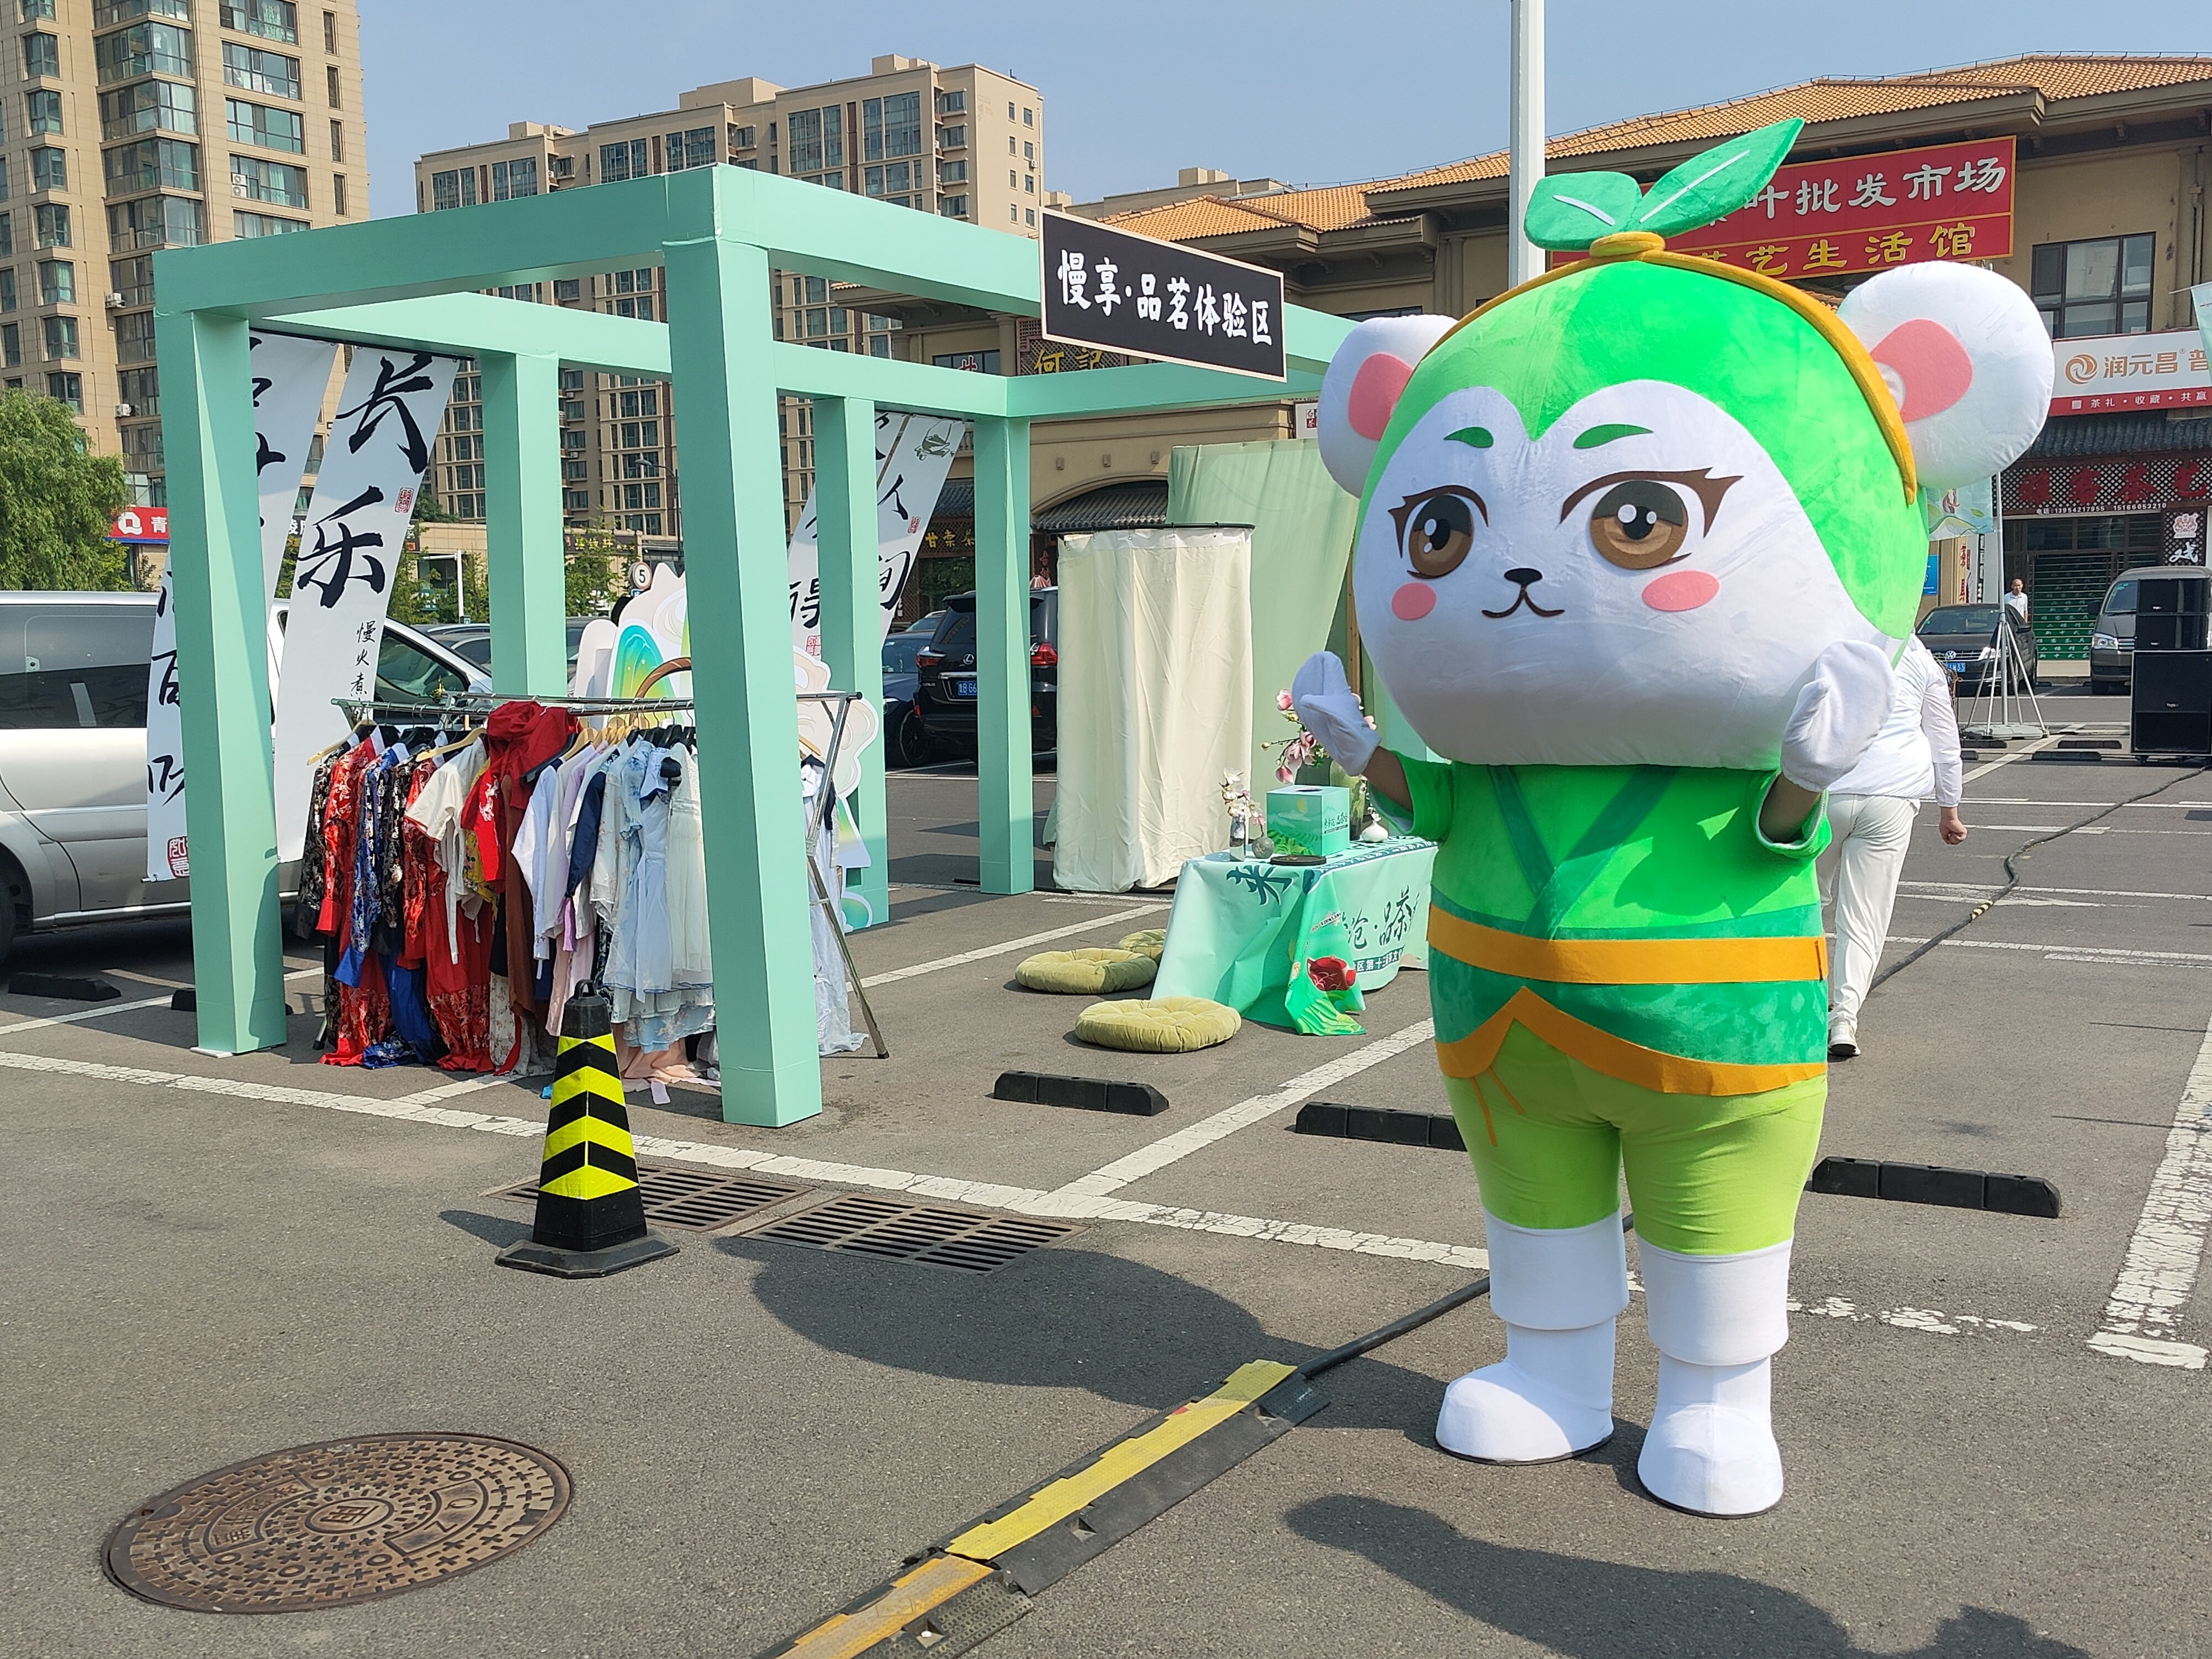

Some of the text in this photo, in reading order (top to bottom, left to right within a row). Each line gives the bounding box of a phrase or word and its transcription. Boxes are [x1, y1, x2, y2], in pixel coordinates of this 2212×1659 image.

[1709, 156, 2006, 226] 叶批发市场
[1057, 249, 1272, 346] 慢享·品茗体验区
[151, 516, 168, 533] 青
[639, 570, 646, 583] 5
